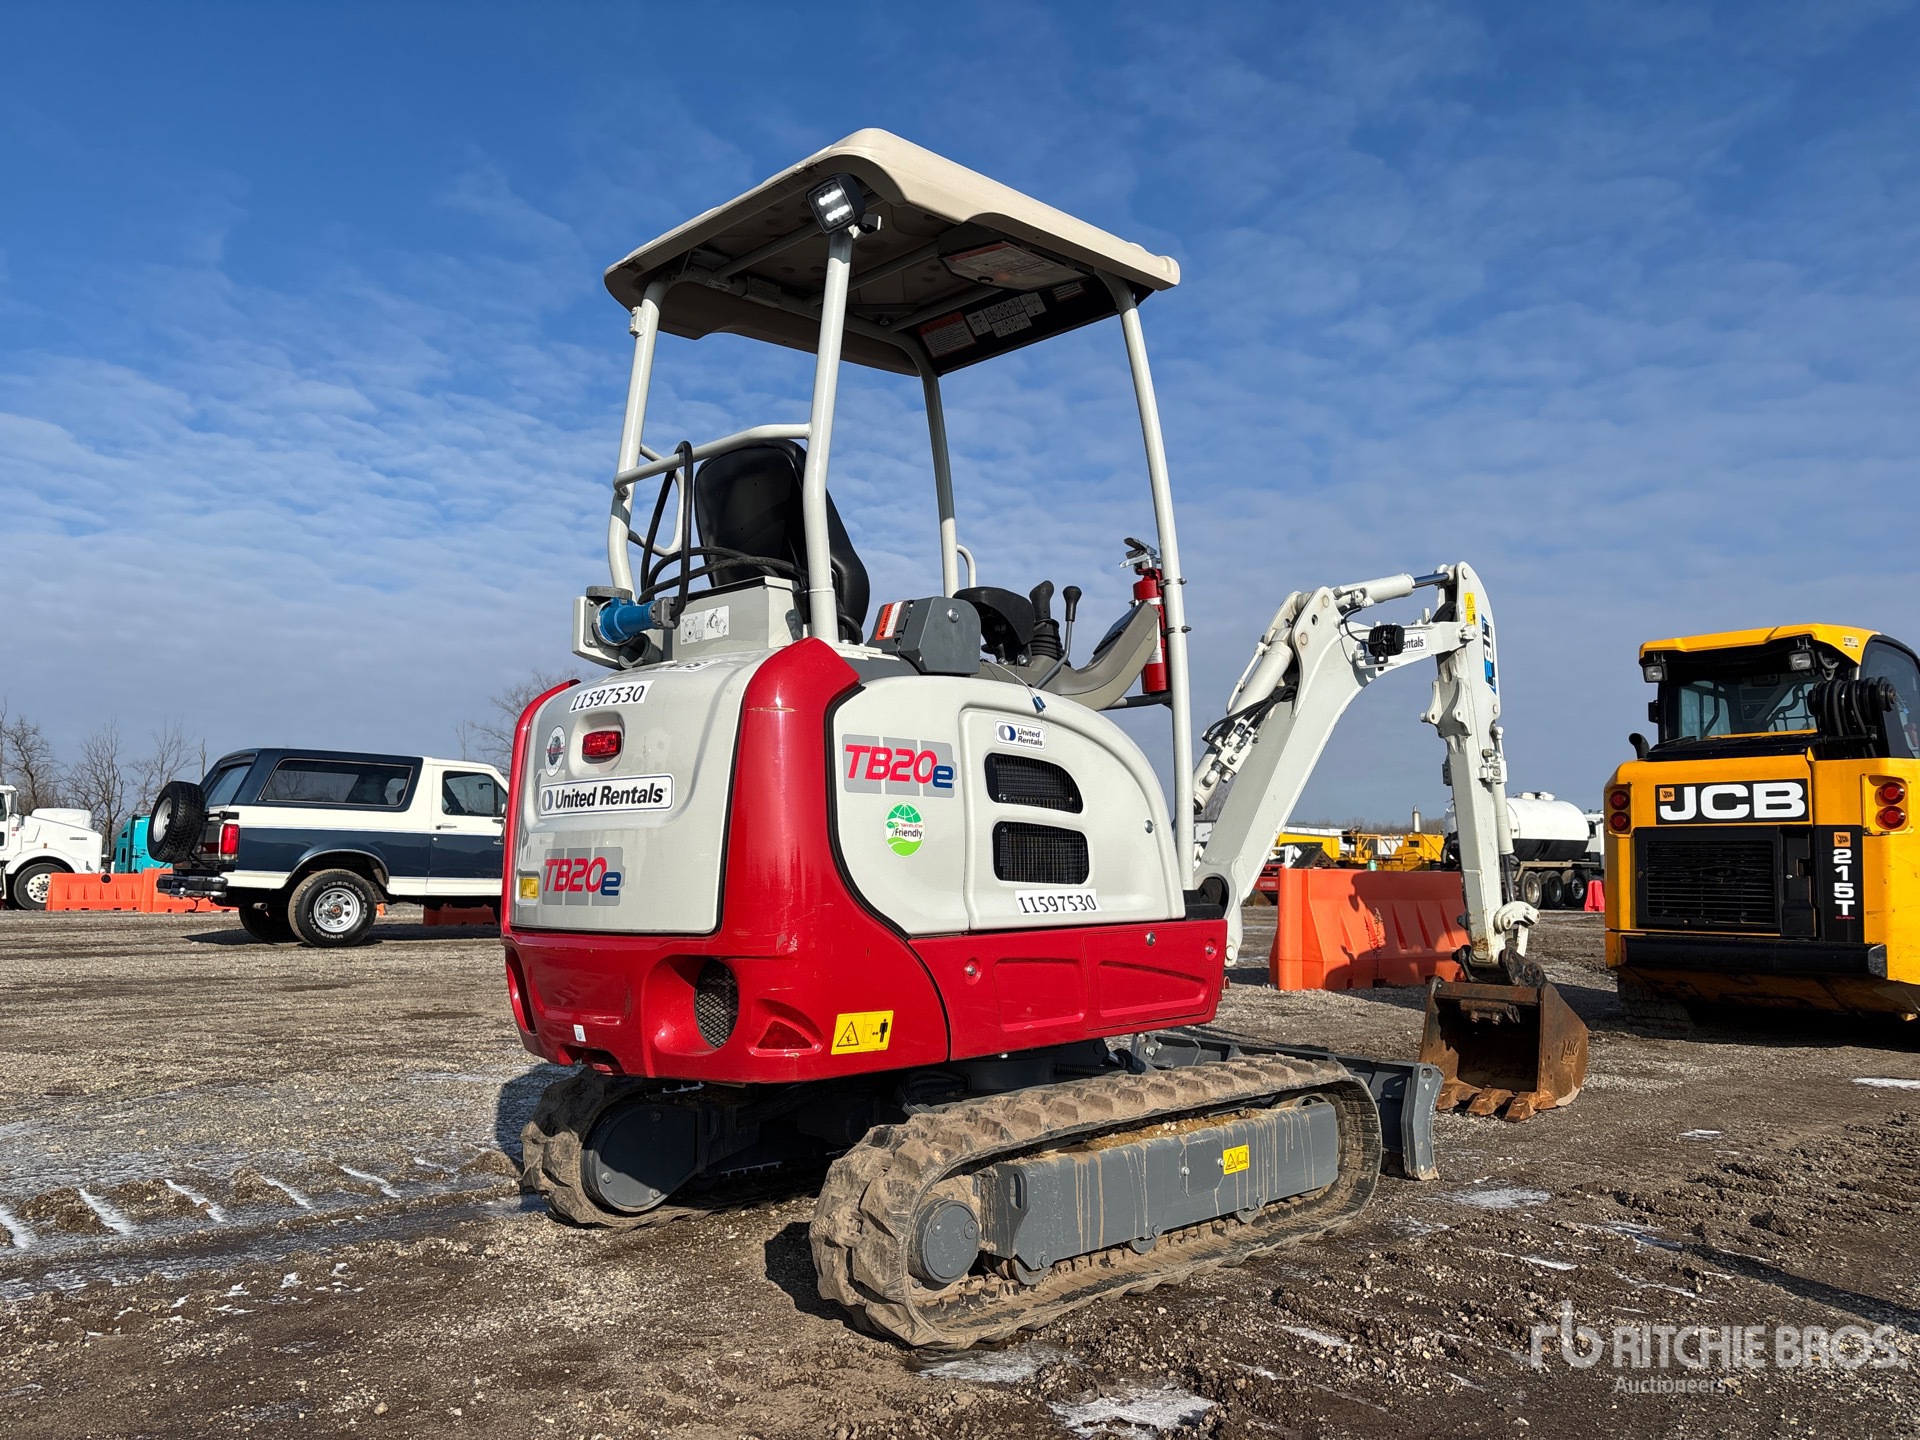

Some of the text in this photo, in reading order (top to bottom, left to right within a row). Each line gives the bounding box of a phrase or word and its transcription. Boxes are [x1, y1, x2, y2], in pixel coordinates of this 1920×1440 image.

[1402, 636, 1424, 649] entals
[571, 685, 645, 711] 11597530
[1017, 728, 1041, 738] United
[1017, 736, 1043, 746] Rentals
[845, 744, 954, 788] TB20e
[555, 783, 663, 809] United Rentals
[1660, 782, 1806, 821] JCB
[894, 828, 923, 839] Friendly
[544, 857, 621, 896] TB20e
[1833, 849, 1855, 916] 215T
[1018, 895, 1097, 913] 11597530
